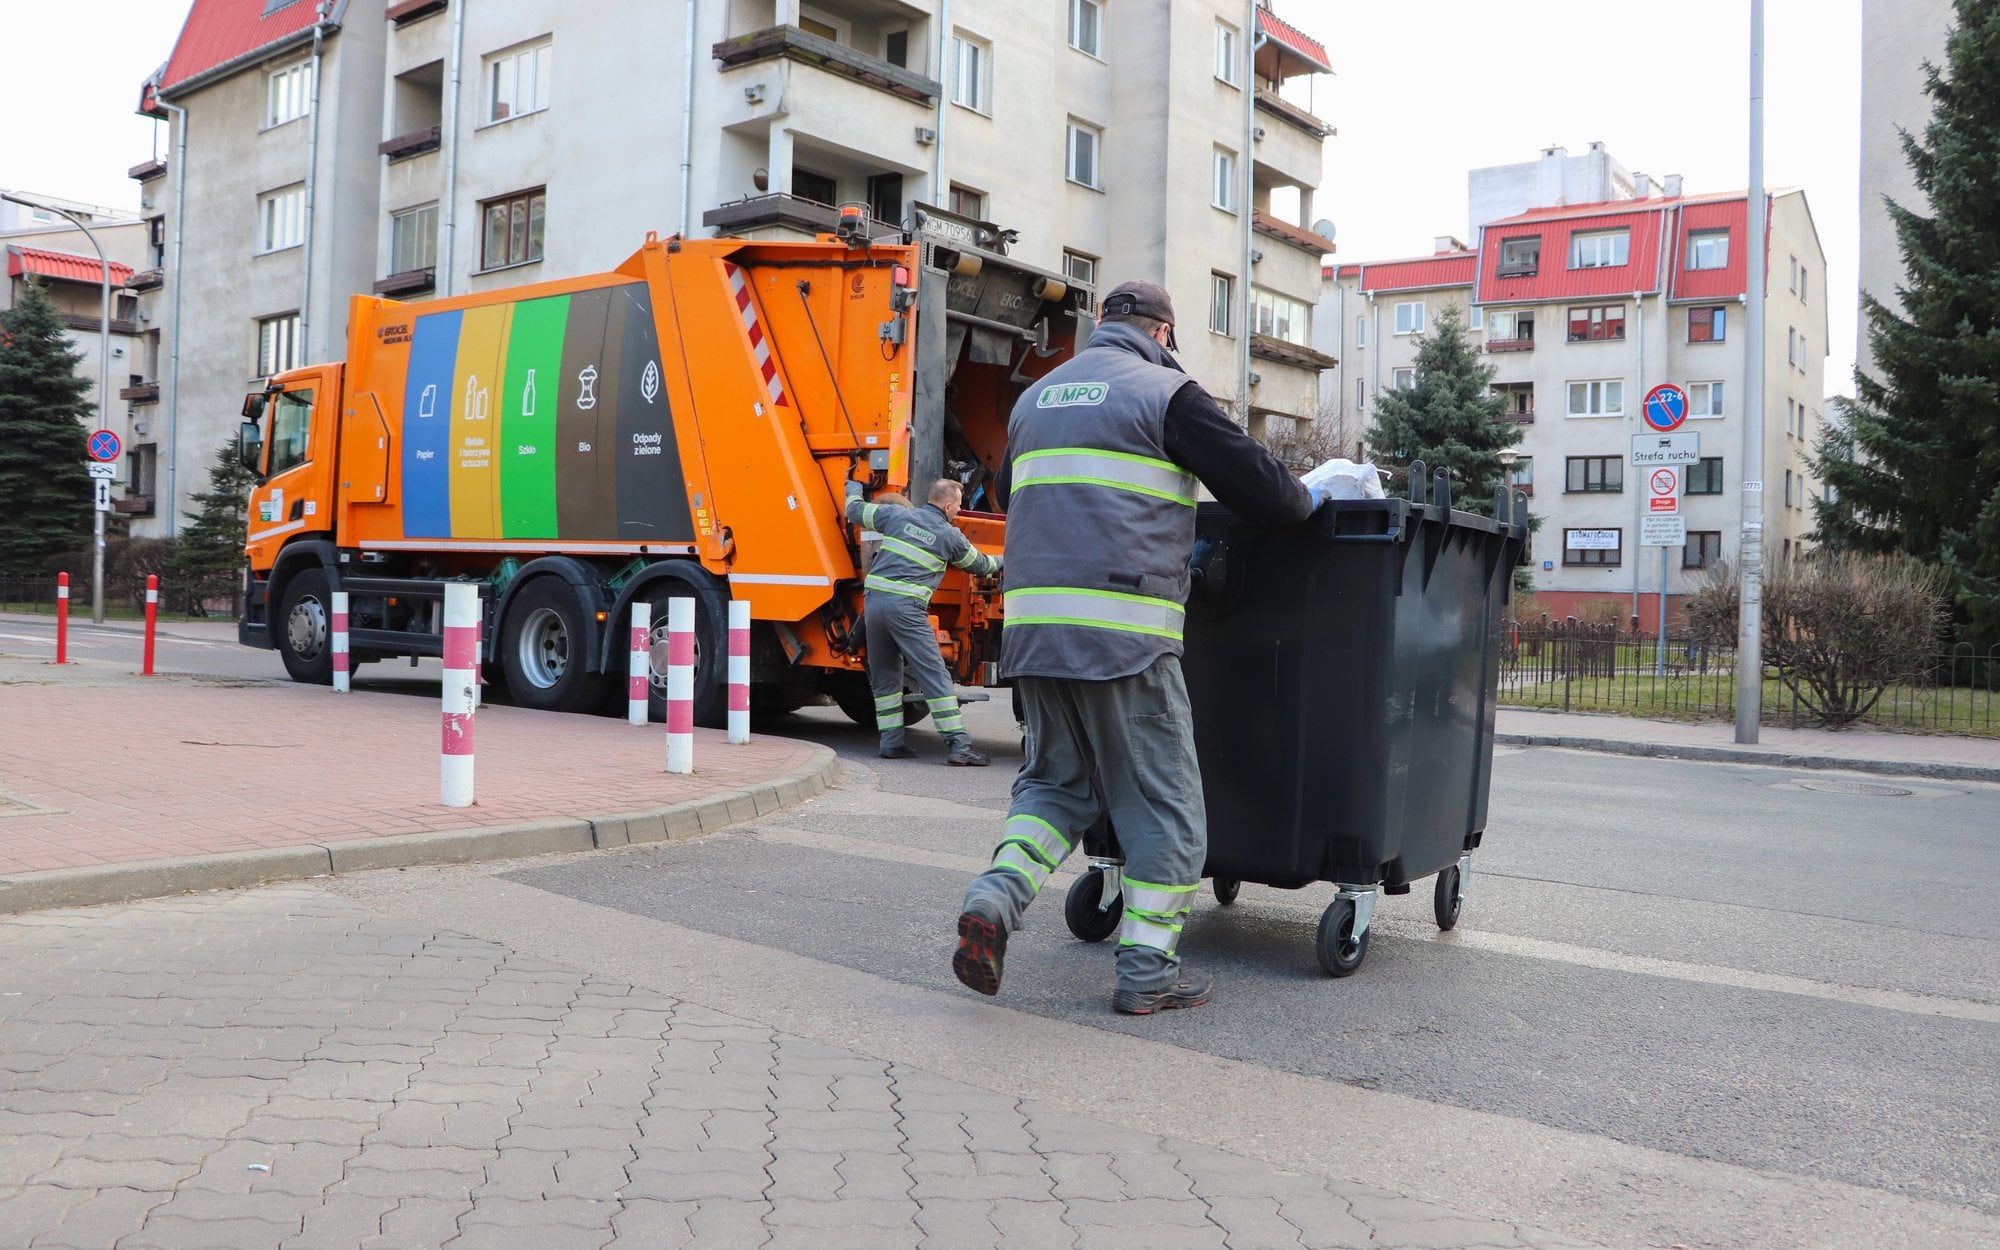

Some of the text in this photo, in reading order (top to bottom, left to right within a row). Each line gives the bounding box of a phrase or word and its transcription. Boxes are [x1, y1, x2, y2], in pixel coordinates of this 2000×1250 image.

[944, 221, 972, 241] 70956
[1060, 387, 1103, 403] MPO
[1660, 390, 1684, 403] 22-6
[464, 437, 485, 446] Metale
[633, 432, 662, 445] Odpady
[518, 445, 537, 455] Szkło
[578, 442, 591, 452] Bio
[634, 445, 661, 456] zielone
[416, 449, 434, 460] Papier
[1634, 450, 1696, 461] Strefa ruchu
[915, 529, 934, 543] MPO
